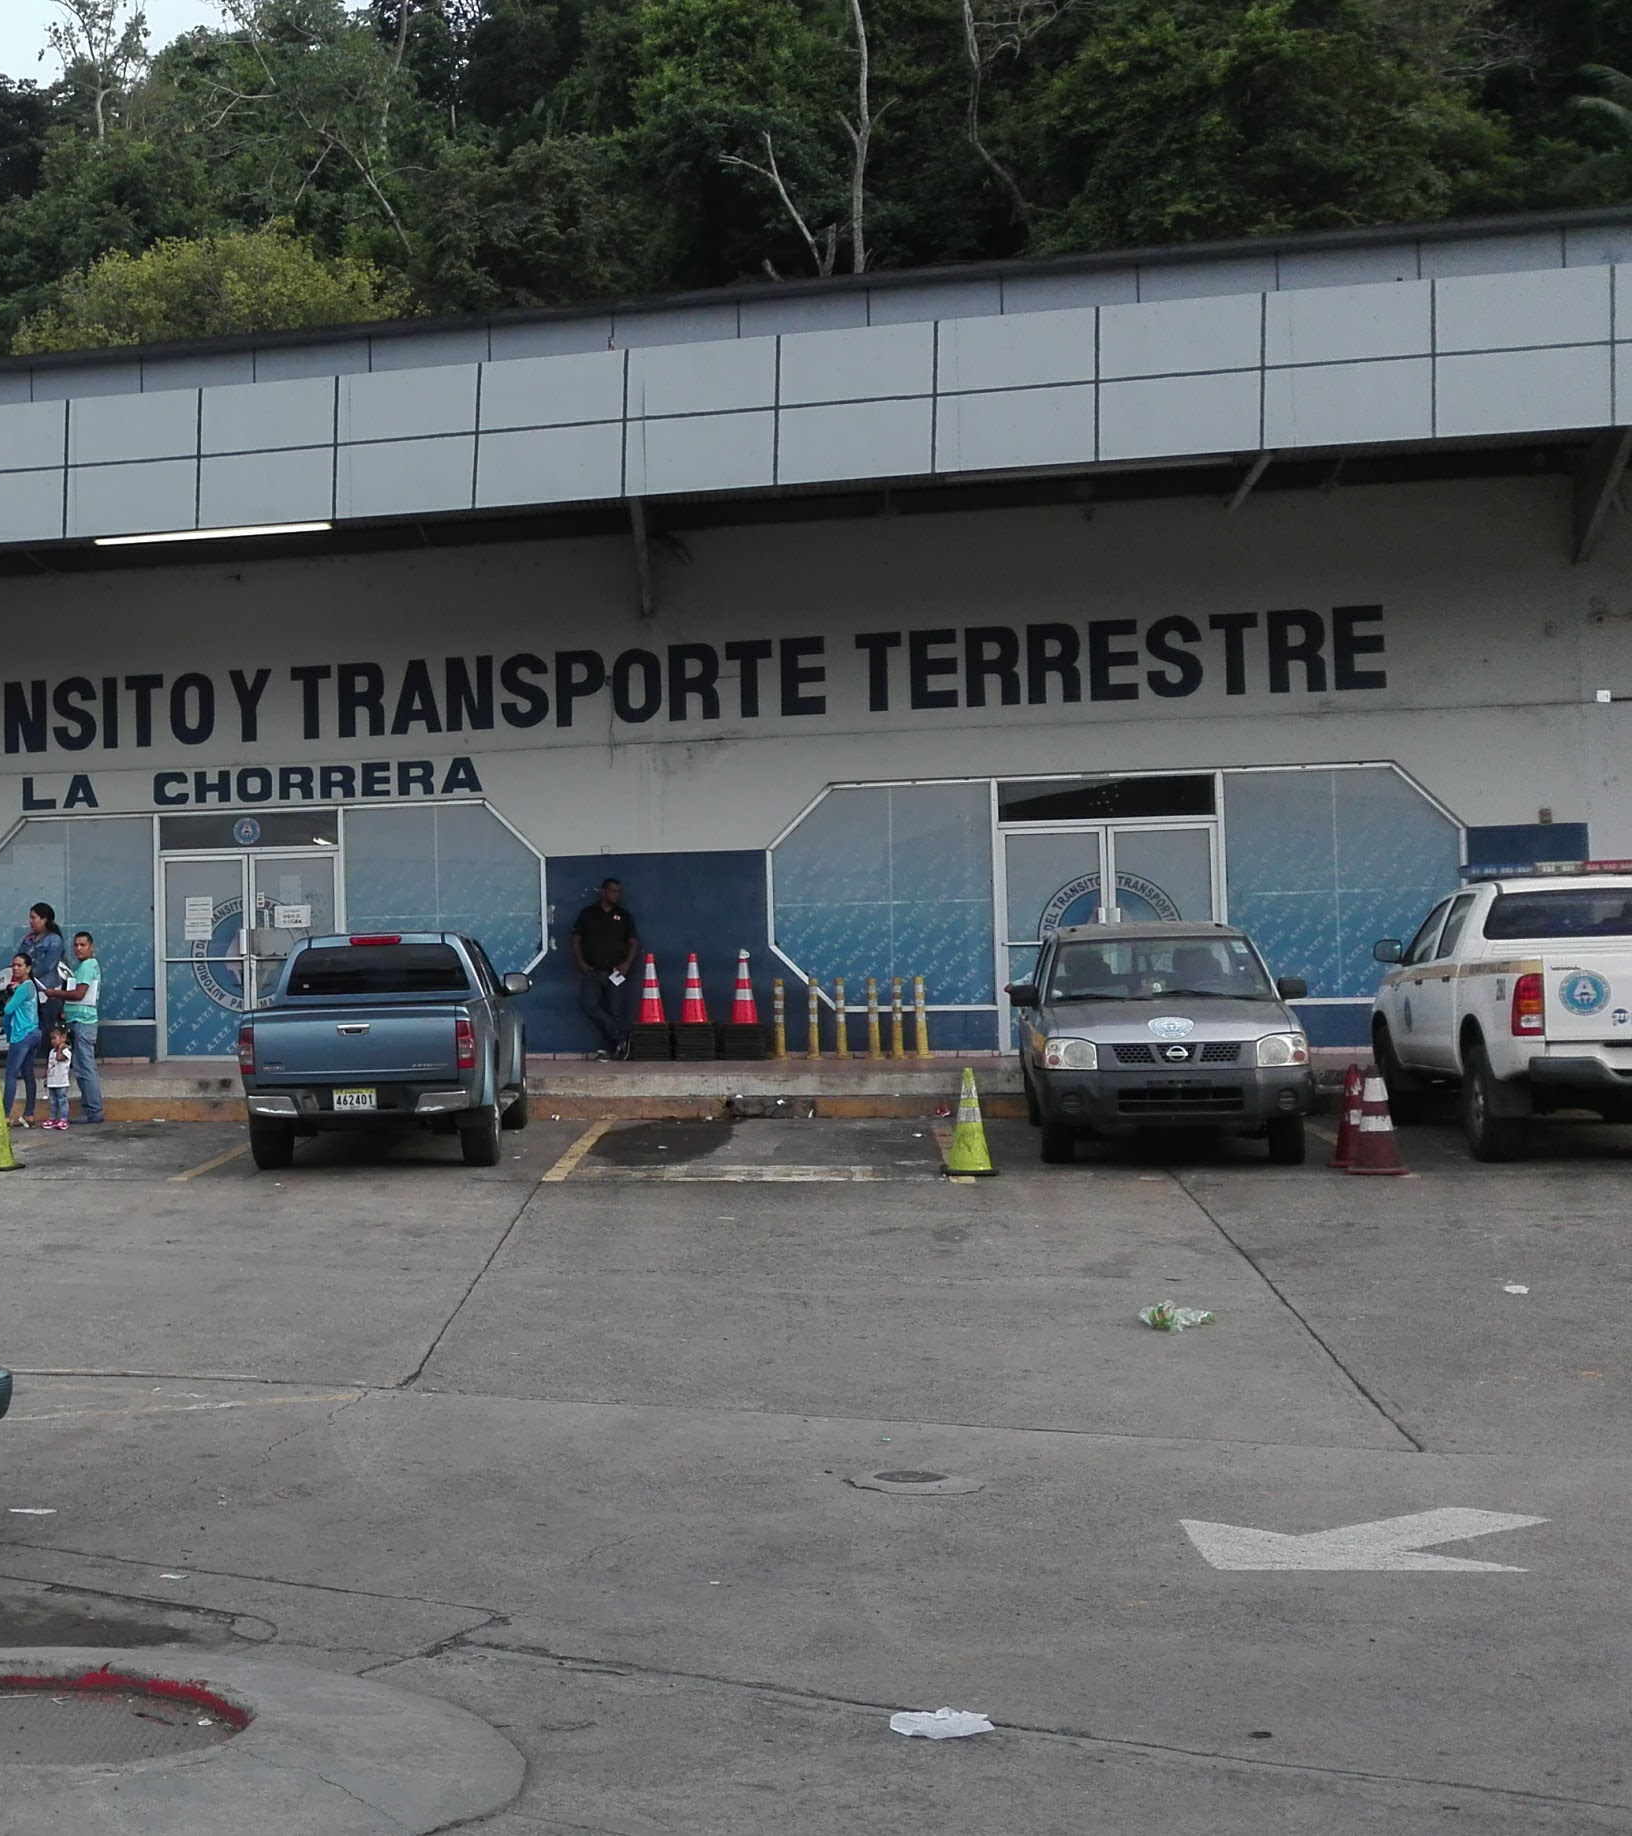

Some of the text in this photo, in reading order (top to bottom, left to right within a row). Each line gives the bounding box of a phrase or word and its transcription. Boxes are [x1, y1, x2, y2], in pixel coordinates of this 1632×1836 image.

[229, 668, 272, 742] Y
[290, 635, 827, 740] TRANSPORTE
[854, 604, 1387, 712] TERRESTRE
[22, 756, 483, 810] LA CHORRERA
[336, 1094, 373, 1106] 462401
